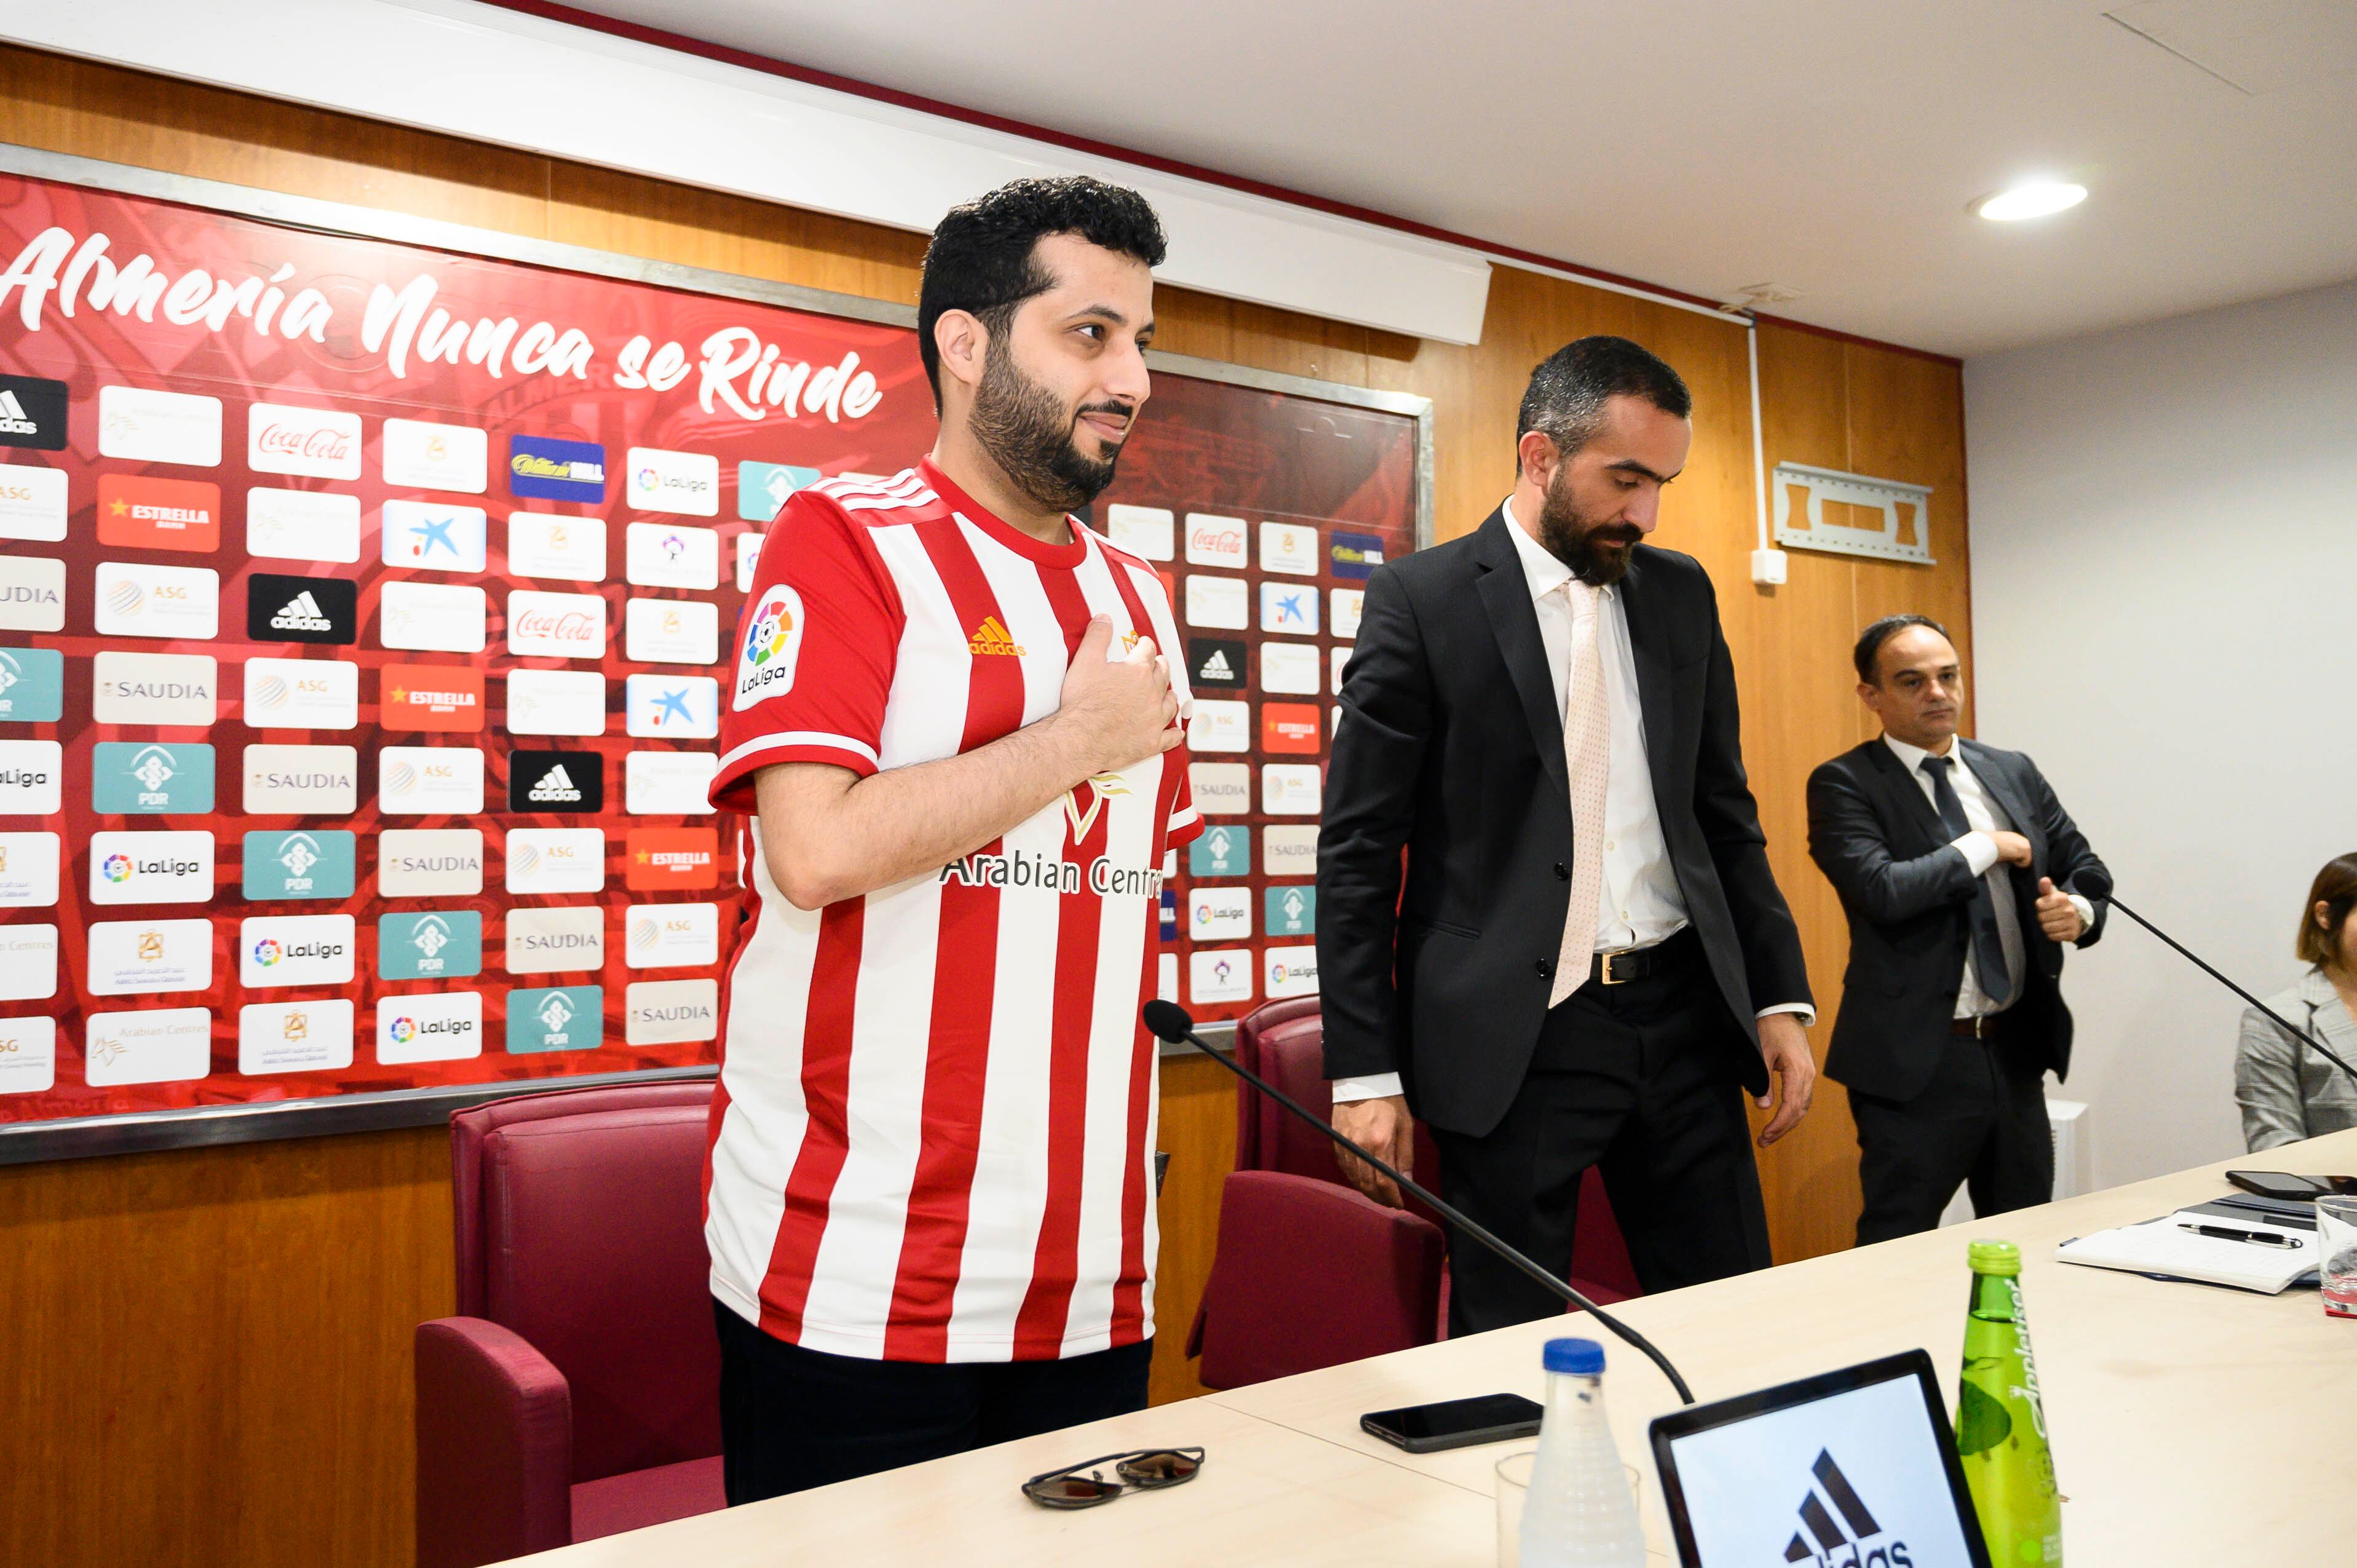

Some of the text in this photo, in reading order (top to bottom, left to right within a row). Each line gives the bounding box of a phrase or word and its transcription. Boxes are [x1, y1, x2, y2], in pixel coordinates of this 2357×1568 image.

[0, 226, 883, 423] Almería Nunca se Rinde
[0, 418, 38, 435] das
[132, 505, 210, 524] ESTRELLA
[0, 587, 59, 604] UDIA
[154, 587, 188, 600] ASG
[271, 616, 332, 632] adidas
[969, 639, 1028, 657] adidas
[297, 680, 328, 693] ASG
[742, 667, 786, 695] LaLiga
[118, 682, 209, 700] SAUDIA
[410, 691, 477, 706] ESTRELLA
[0, 769, 47, 788] Liga
[424, 766, 453, 778] ASG
[267, 774, 352, 790] SAUDIA
[138, 792, 169, 806] PDR
[529, 787, 582, 802] adidas
[548, 847, 574, 858] ASG
[652, 852, 711, 866] ESTRELLA
[139, 858, 199, 877] LaLiga
[403, 857, 480, 873] SAUDIA
[938, 850, 1164, 900] Arabian Centre
[285, 877, 313, 890] PDR
[666, 921, 692, 932] ASG
[526, 933, 599, 950] SAUDIA
[287, 941, 343, 960] LaLiga
[418, 958, 445, 971] PDR
[643, 1006, 711, 1023] SAUDIA
[119, 1027, 164, 1038] Arabian
[421, 1018, 472, 1035] LaLiga
[0, 1039, 18, 1054] SG
[544, 1033, 569, 1046] PDR
